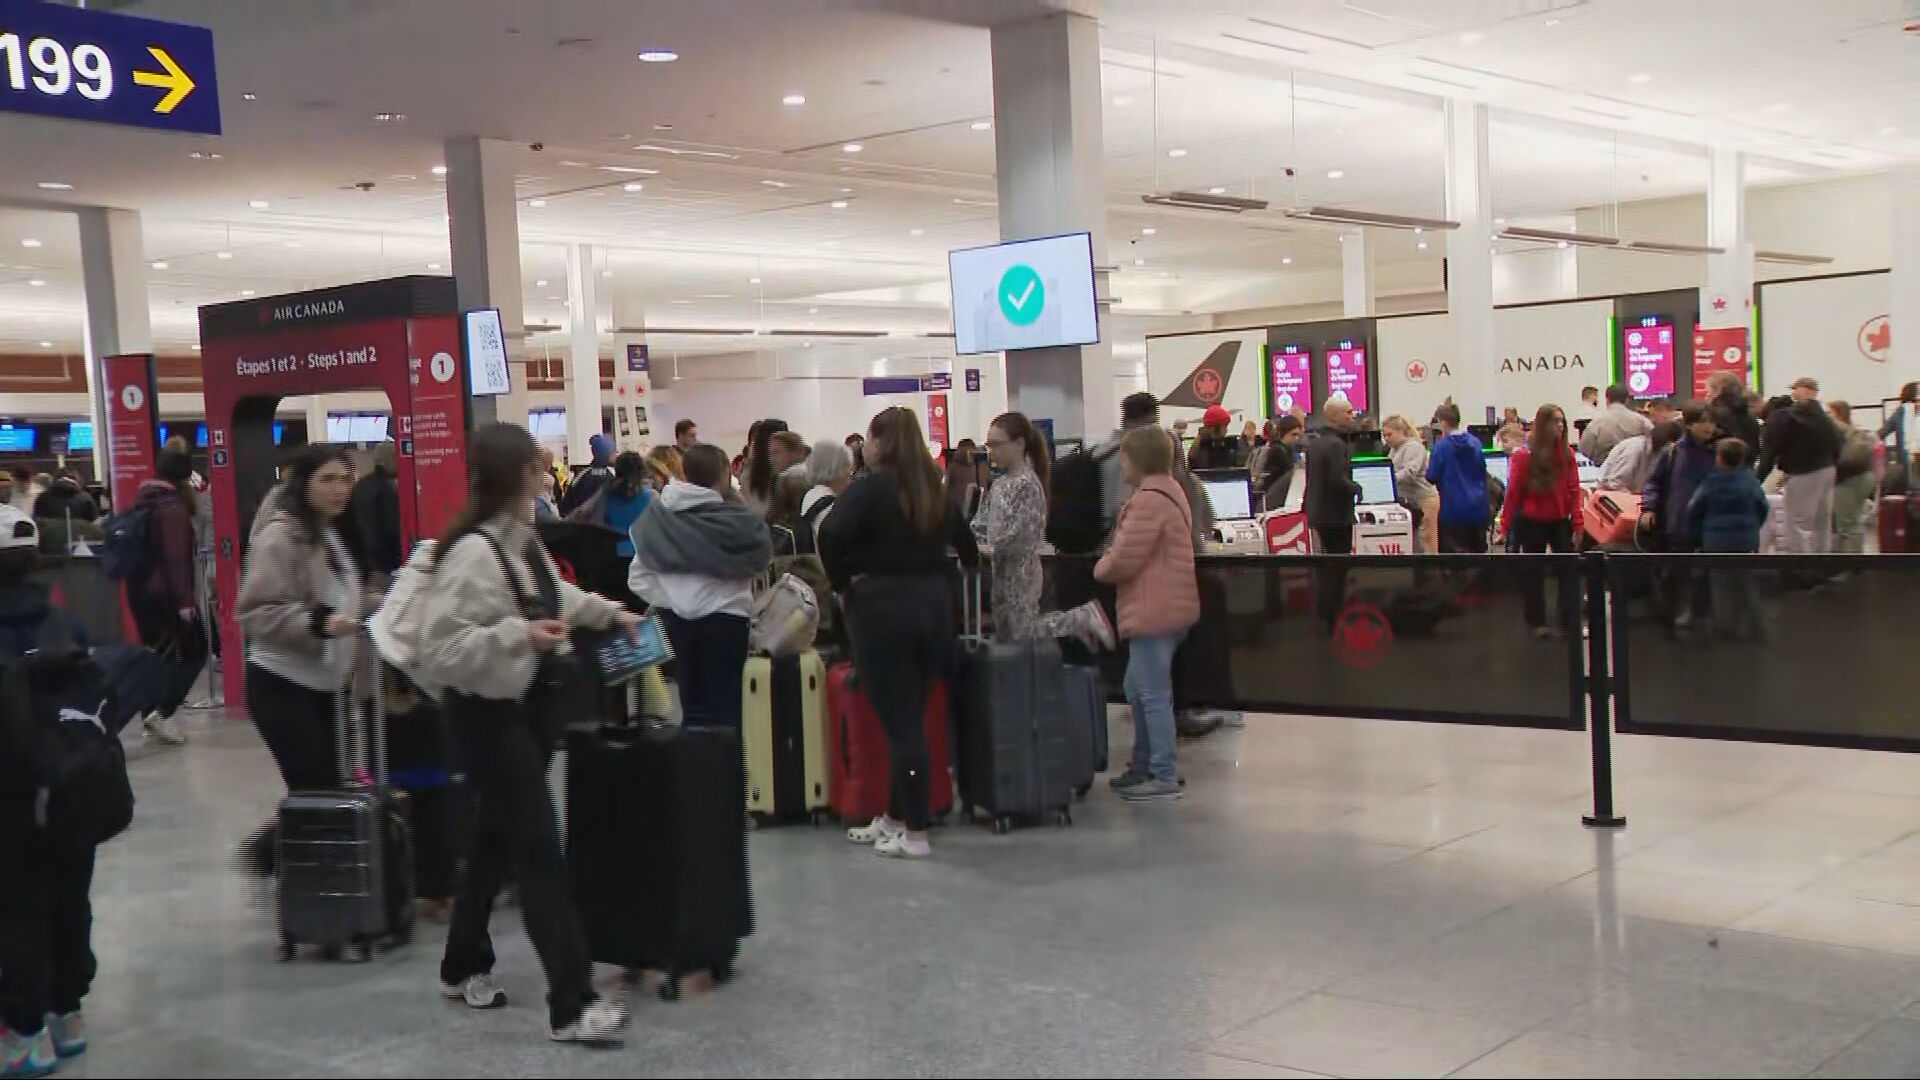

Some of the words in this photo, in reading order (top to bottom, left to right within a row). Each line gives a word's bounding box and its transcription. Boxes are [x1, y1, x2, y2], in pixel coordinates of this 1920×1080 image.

[0, 32, 114, 100] 199
[273, 305, 293, 320] AIR
[294, 300, 345, 318] CANADA
[236, 356, 270, 377] Étapes
[278, 357, 288, 372] et
[290, 354, 297, 370] 2
[307, 351, 338, 370] Steps
[346, 346, 367, 364] and
[369, 346, 377, 362] 2
[1500, 354, 1585, 374] ANADA
